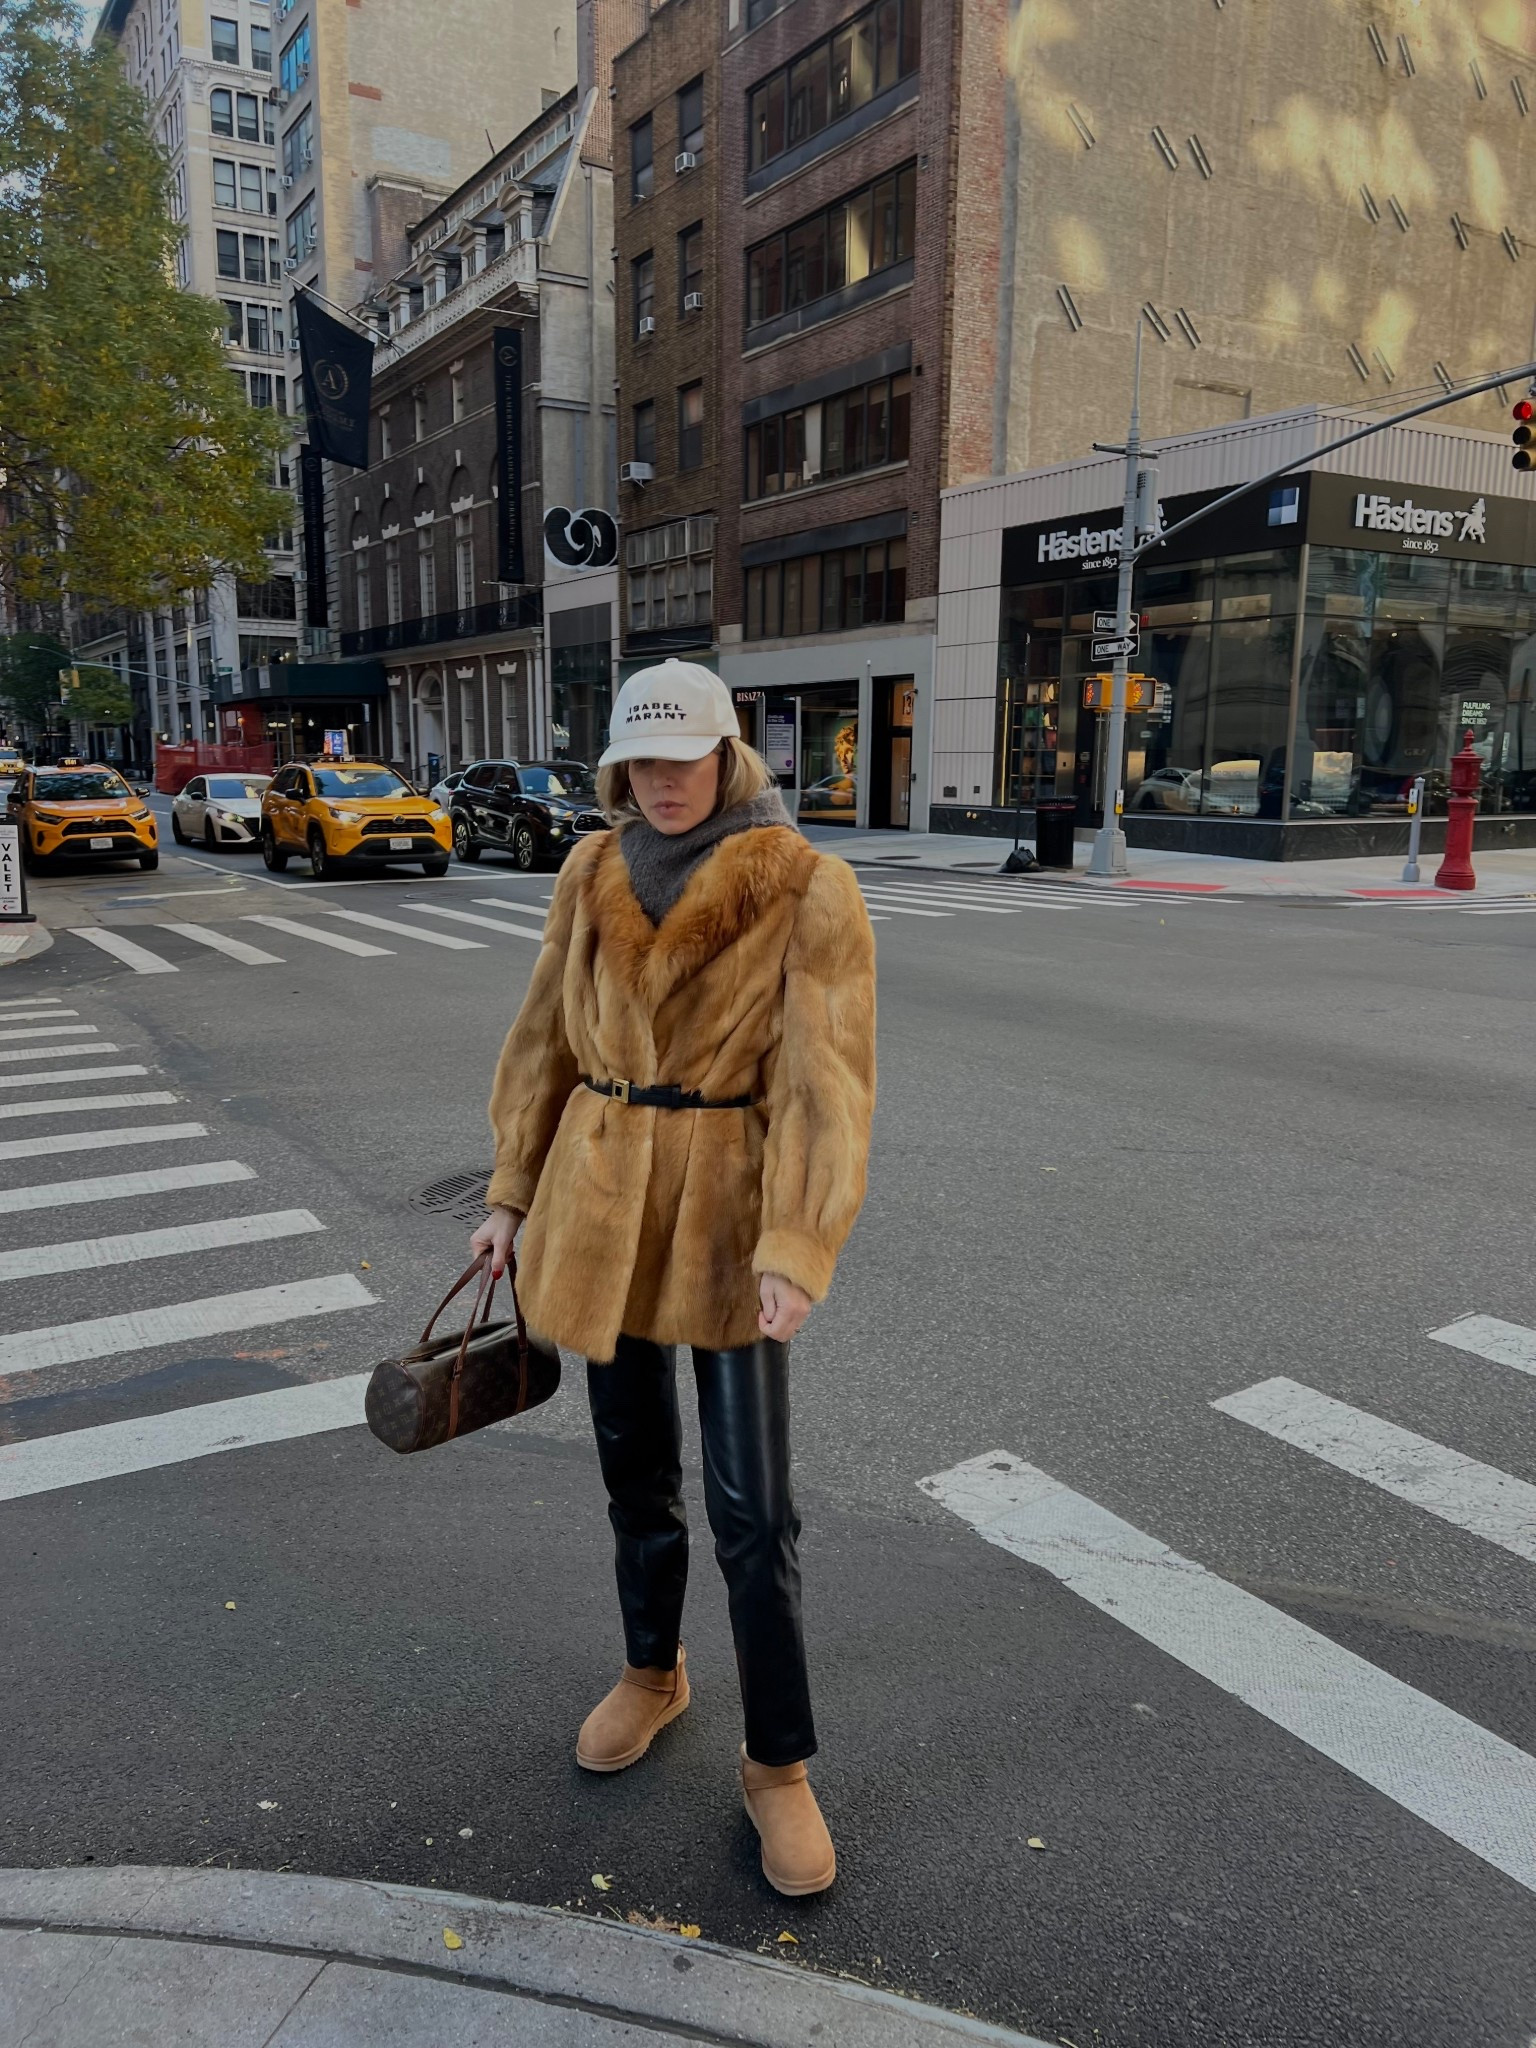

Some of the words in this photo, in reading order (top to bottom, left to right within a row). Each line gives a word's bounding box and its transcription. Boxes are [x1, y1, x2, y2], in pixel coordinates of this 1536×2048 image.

[505, 395, 514, 442] AMERICAN
[1402, 537, 1423, 551] since
[1423, 539, 1440, 554] 1852
[1081, 558, 1102, 570] since
[1102, 556, 1118, 569] 1852
[1098, 618, 1111, 627] ONE
[1096, 644, 1109, 654] ONE
[1117, 641, 1131, 652] WAY
[629, 702, 683, 715] ISABEL
[625, 711, 687, 725] MARANT
[1, 843, 13, 893] VALET
